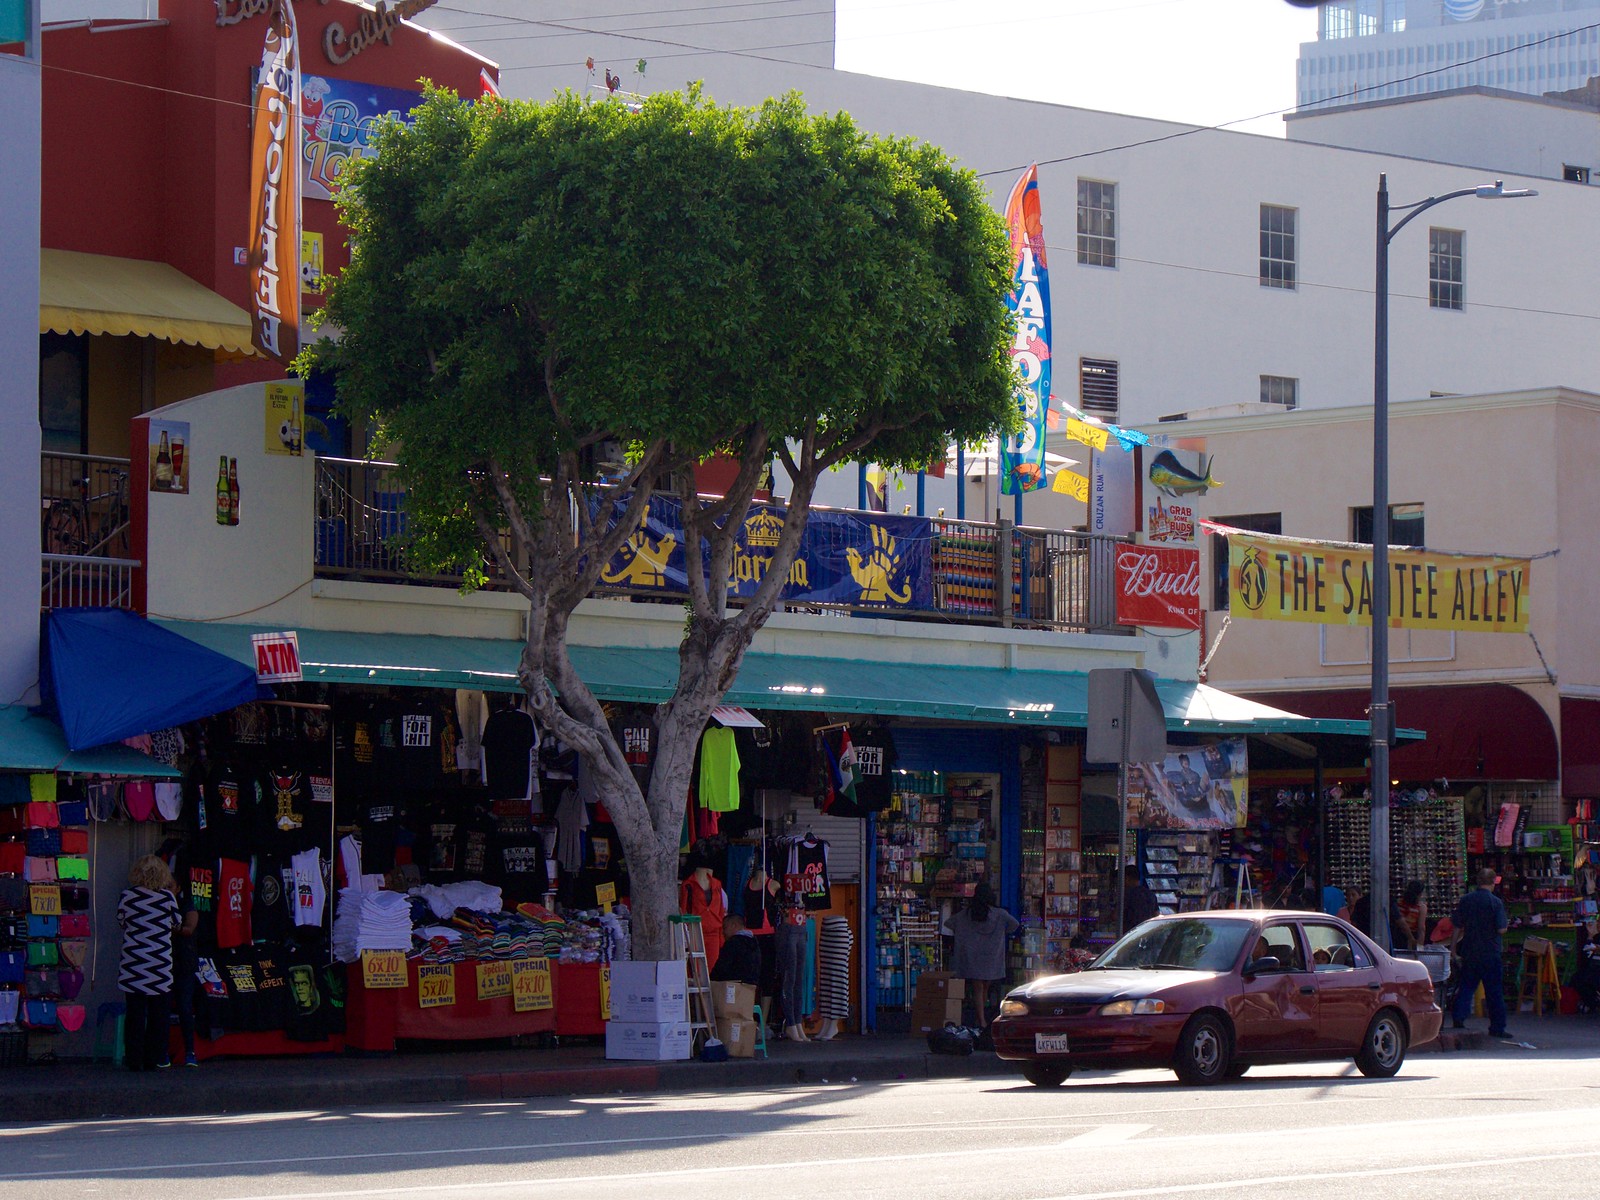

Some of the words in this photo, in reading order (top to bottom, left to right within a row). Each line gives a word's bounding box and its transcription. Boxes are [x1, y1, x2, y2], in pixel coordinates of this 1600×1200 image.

[1096, 474, 1104, 492] RUM
[1096, 496, 1104, 530] CRUZAN
[1169, 505, 1192, 517] GRAB
[1170, 522, 1193, 533] BUDS
[1275, 553, 1326, 613] THE
[1341, 558, 1438, 619] SATEE
[1451, 567, 1522, 623] ALLEY
[1167, 605, 1184, 615] KING
[257, 642, 298, 676] ATM
[406, 722, 426, 733] FOR
[857, 752, 877, 763] FOR
[786, 878, 793, 892] 3
[420, 965, 452, 978] SPECIAL
[513, 960, 549, 974] SPECIAL
[496, 973, 511, 986] $10
